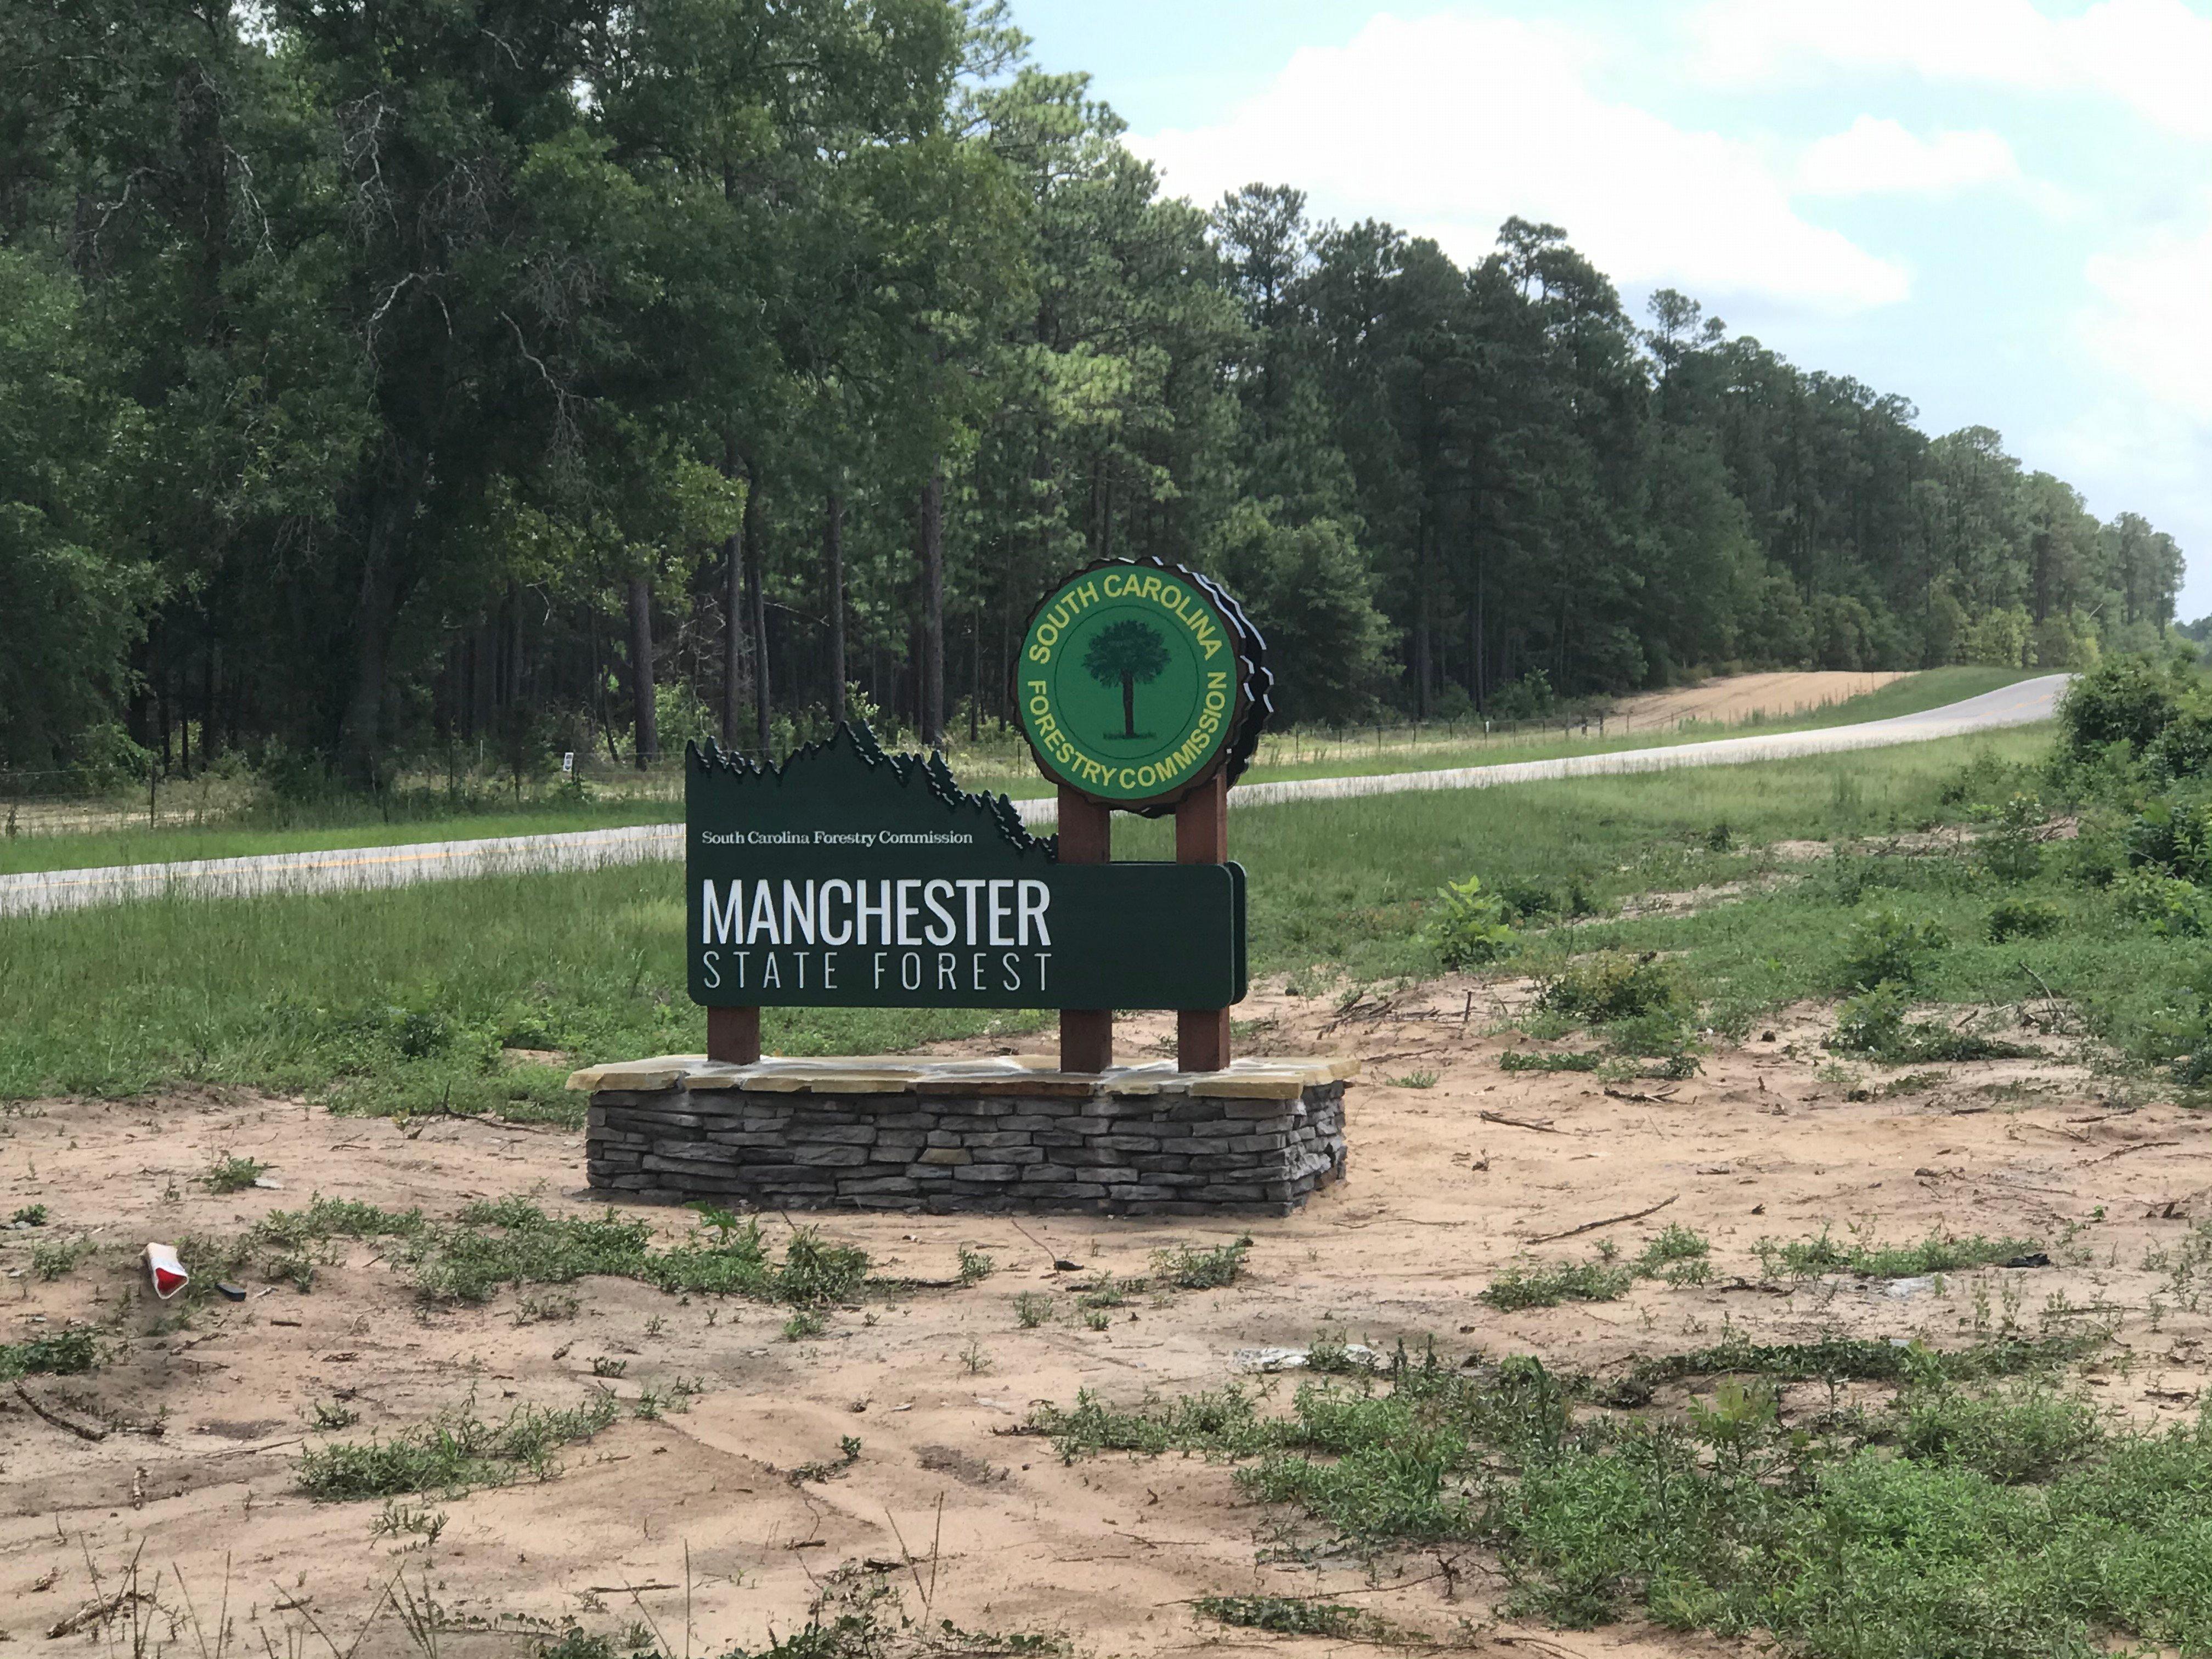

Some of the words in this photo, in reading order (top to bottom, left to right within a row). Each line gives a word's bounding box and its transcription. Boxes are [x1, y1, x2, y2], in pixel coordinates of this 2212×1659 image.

[1029, 582, 1099, 664] SOUTH
[1104, 574, 1222, 661] CAROLINA
[1028, 680, 1117, 787] FORESTRY
[1119, 672, 1227, 789] COMMISSION
[702, 831, 745, 844] South
[748, 831, 810, 844] Carolina
[813, 831, 877, 847] Forestry
[878, 831, 973, 844] Commission
[702, 879, 1051, 946] MANCHESTER
[703, 951, 838, 989] STATE
[874, 952, 1052, 991] FOREST
